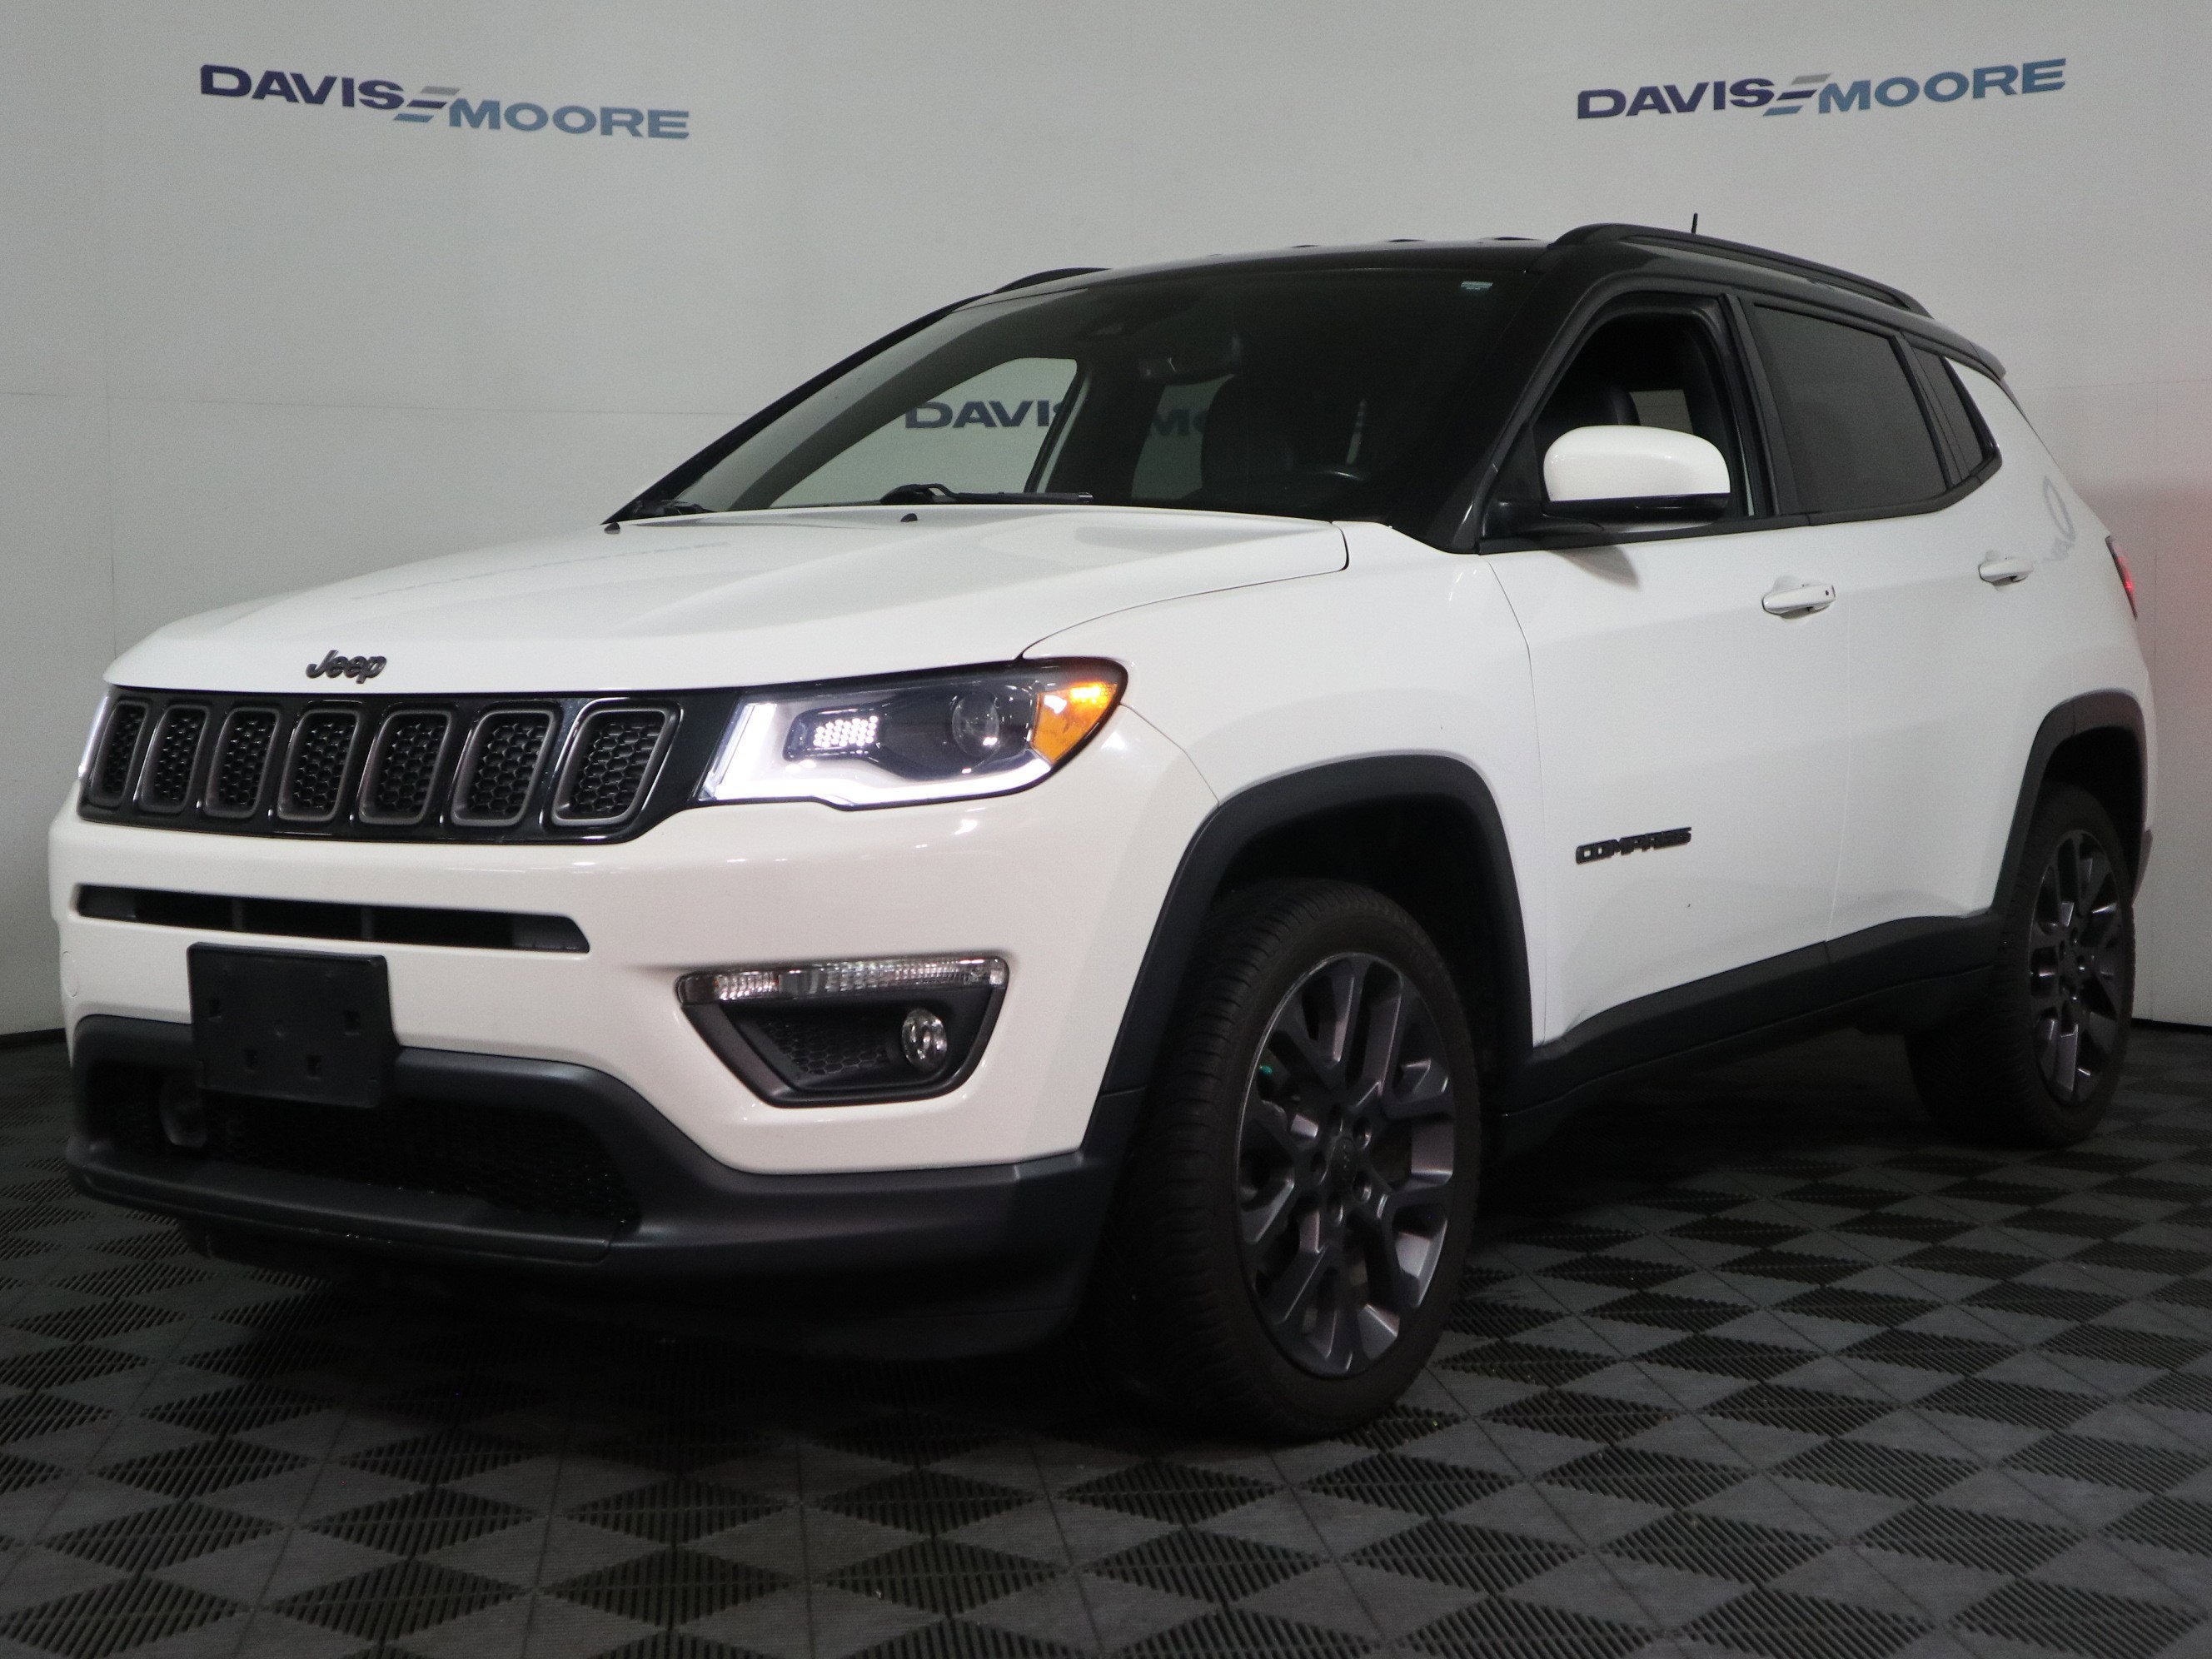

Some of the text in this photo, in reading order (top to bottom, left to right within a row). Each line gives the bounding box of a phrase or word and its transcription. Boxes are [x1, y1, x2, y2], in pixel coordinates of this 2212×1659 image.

[201, 64, 690, 140] DAVIS MOORE
[1577, 57, 2066, 119] DAVIS MOORE
[905, 400, 1064, 428] DAVI
[306, 650, 386, 684] Jeep
